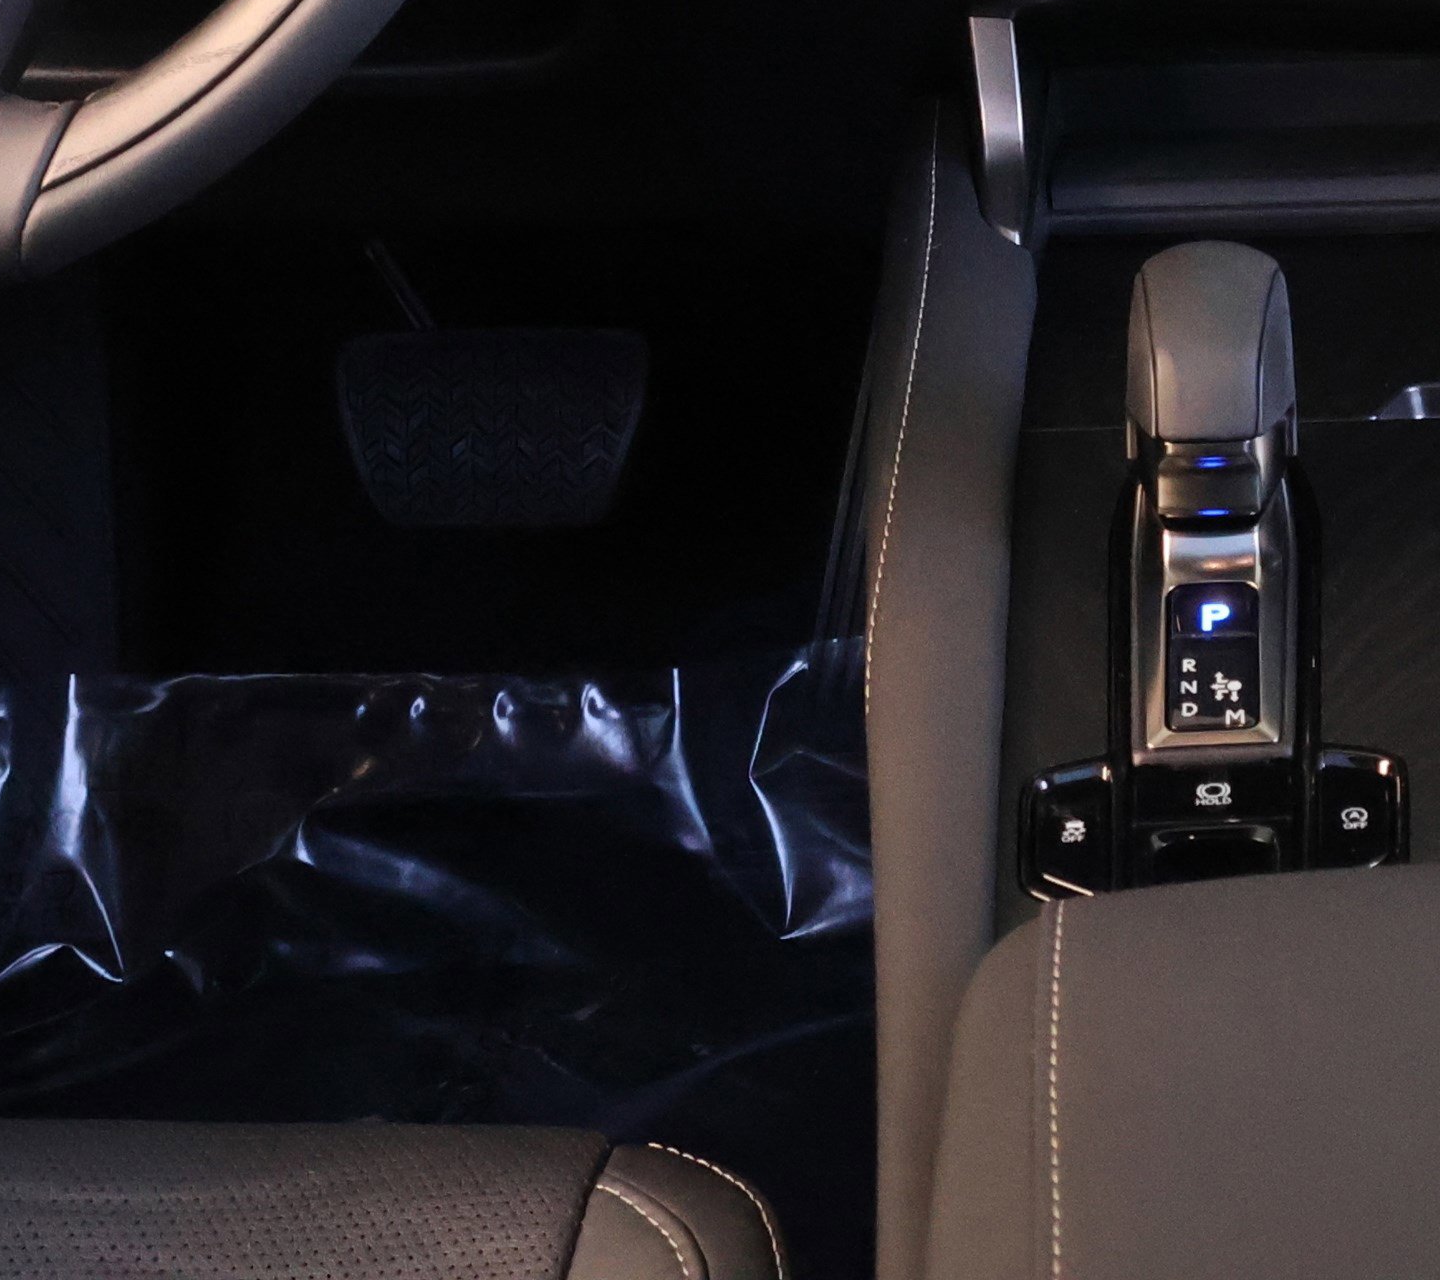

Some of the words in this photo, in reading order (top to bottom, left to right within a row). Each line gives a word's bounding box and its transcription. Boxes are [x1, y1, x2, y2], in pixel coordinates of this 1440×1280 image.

[1201, 603, 1231, 631] P
[1181, 658, 1196, 673] R
[1180, 680, 1197, 694] N
[1181, 702, 1198, 717] D
[1224, 709, 1245, 725] M
[1195, 797, 1232, 805] HOLD
[1343, 821, 1368, 830] OFF
[1061, 832, 1086, 843] OFF
